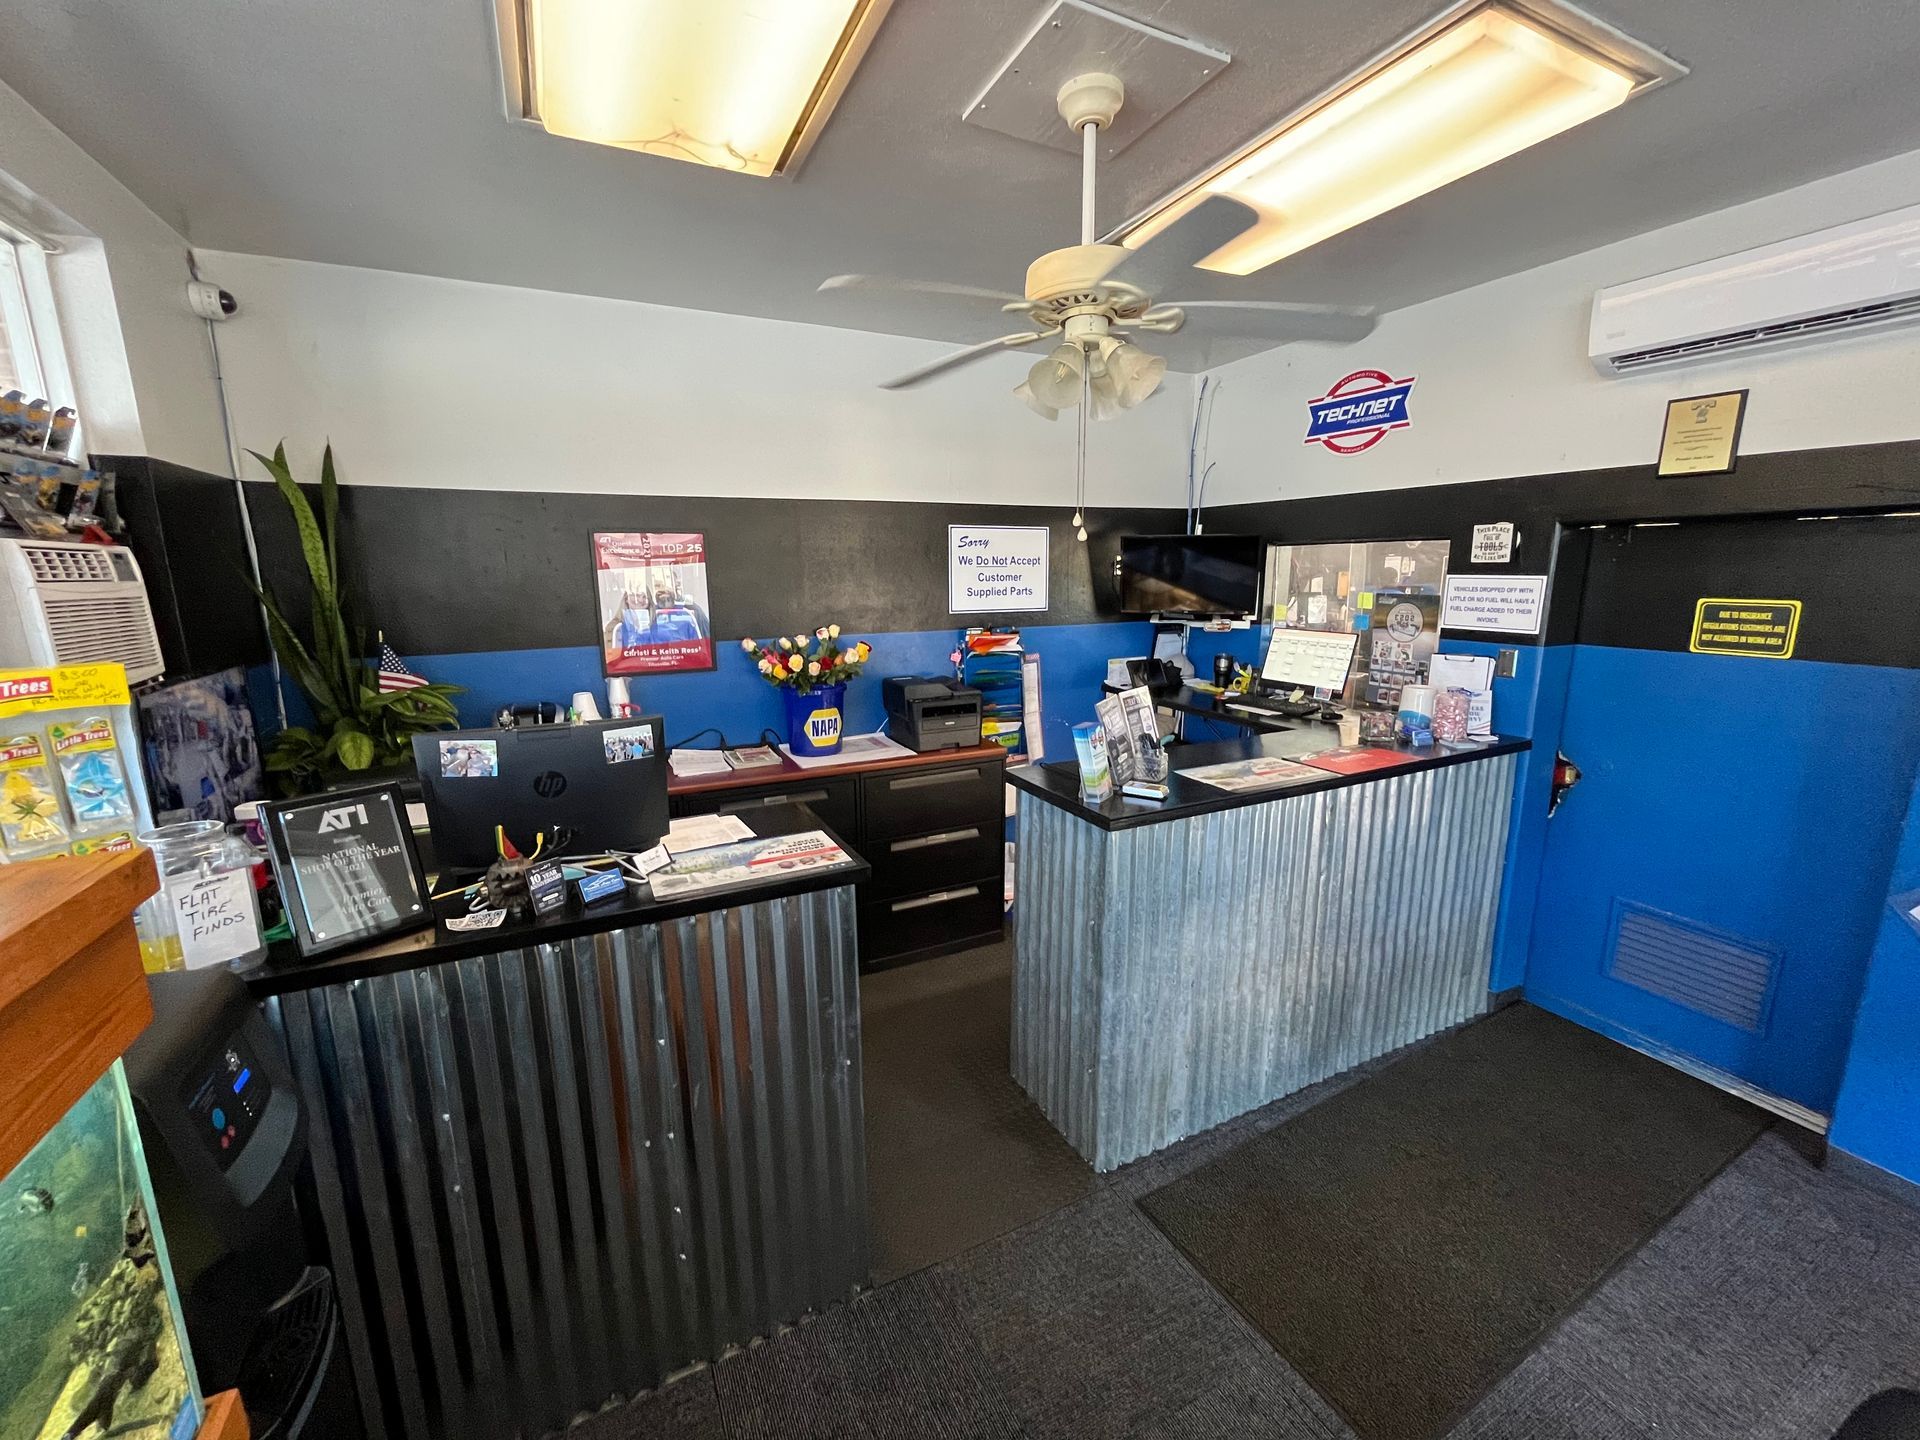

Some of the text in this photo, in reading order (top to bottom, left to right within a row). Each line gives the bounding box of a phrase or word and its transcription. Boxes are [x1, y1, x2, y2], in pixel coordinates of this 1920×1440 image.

[1341, 373, 1378, 385] AUTOMOTIVE
[1318, 394, 1404, 424] TECHNET
[1346, 413, 1390, 424] PROFESSIONAL
[1492, 526, 1511, 534] PLACE
[642, 537, 651, 558] 2021
[662, 544, 702, 552] TOP 25
[958, 536, 990, 548] Sorry
[1480, 542, 1504, 552] TOOLS
[958, 556, 1040, 567] We Do Not Accept
[978, 572, 1022, 582] Customer
[966, 587, 1032, 598] Supplied Parts
[1486, 606, 1506, 614] ADDED
[1740, 612, 1772, 620] INSURANCE
[0, 680, 48, 698] Trees
[812, 718, 838, 737] NAPA
[56, 730, 110, 751] Little Trees
[12, 746, 39, 758] Trees
[537, 772, 565, 799] hp
[318, 804, 369, 834] ATI
[322, 842, 380, 862] NATIONAL
[300, 845, 401, 875] SHOP OF THE YEAR
[344, 862, 366, 873] 2021
[530, 870, 558, 885] 10 YEAR
[179, 886, 222, 910] FLAT
[185, 899, 232, 925] TIRE
[194, 912, 245, 942] FINDS
